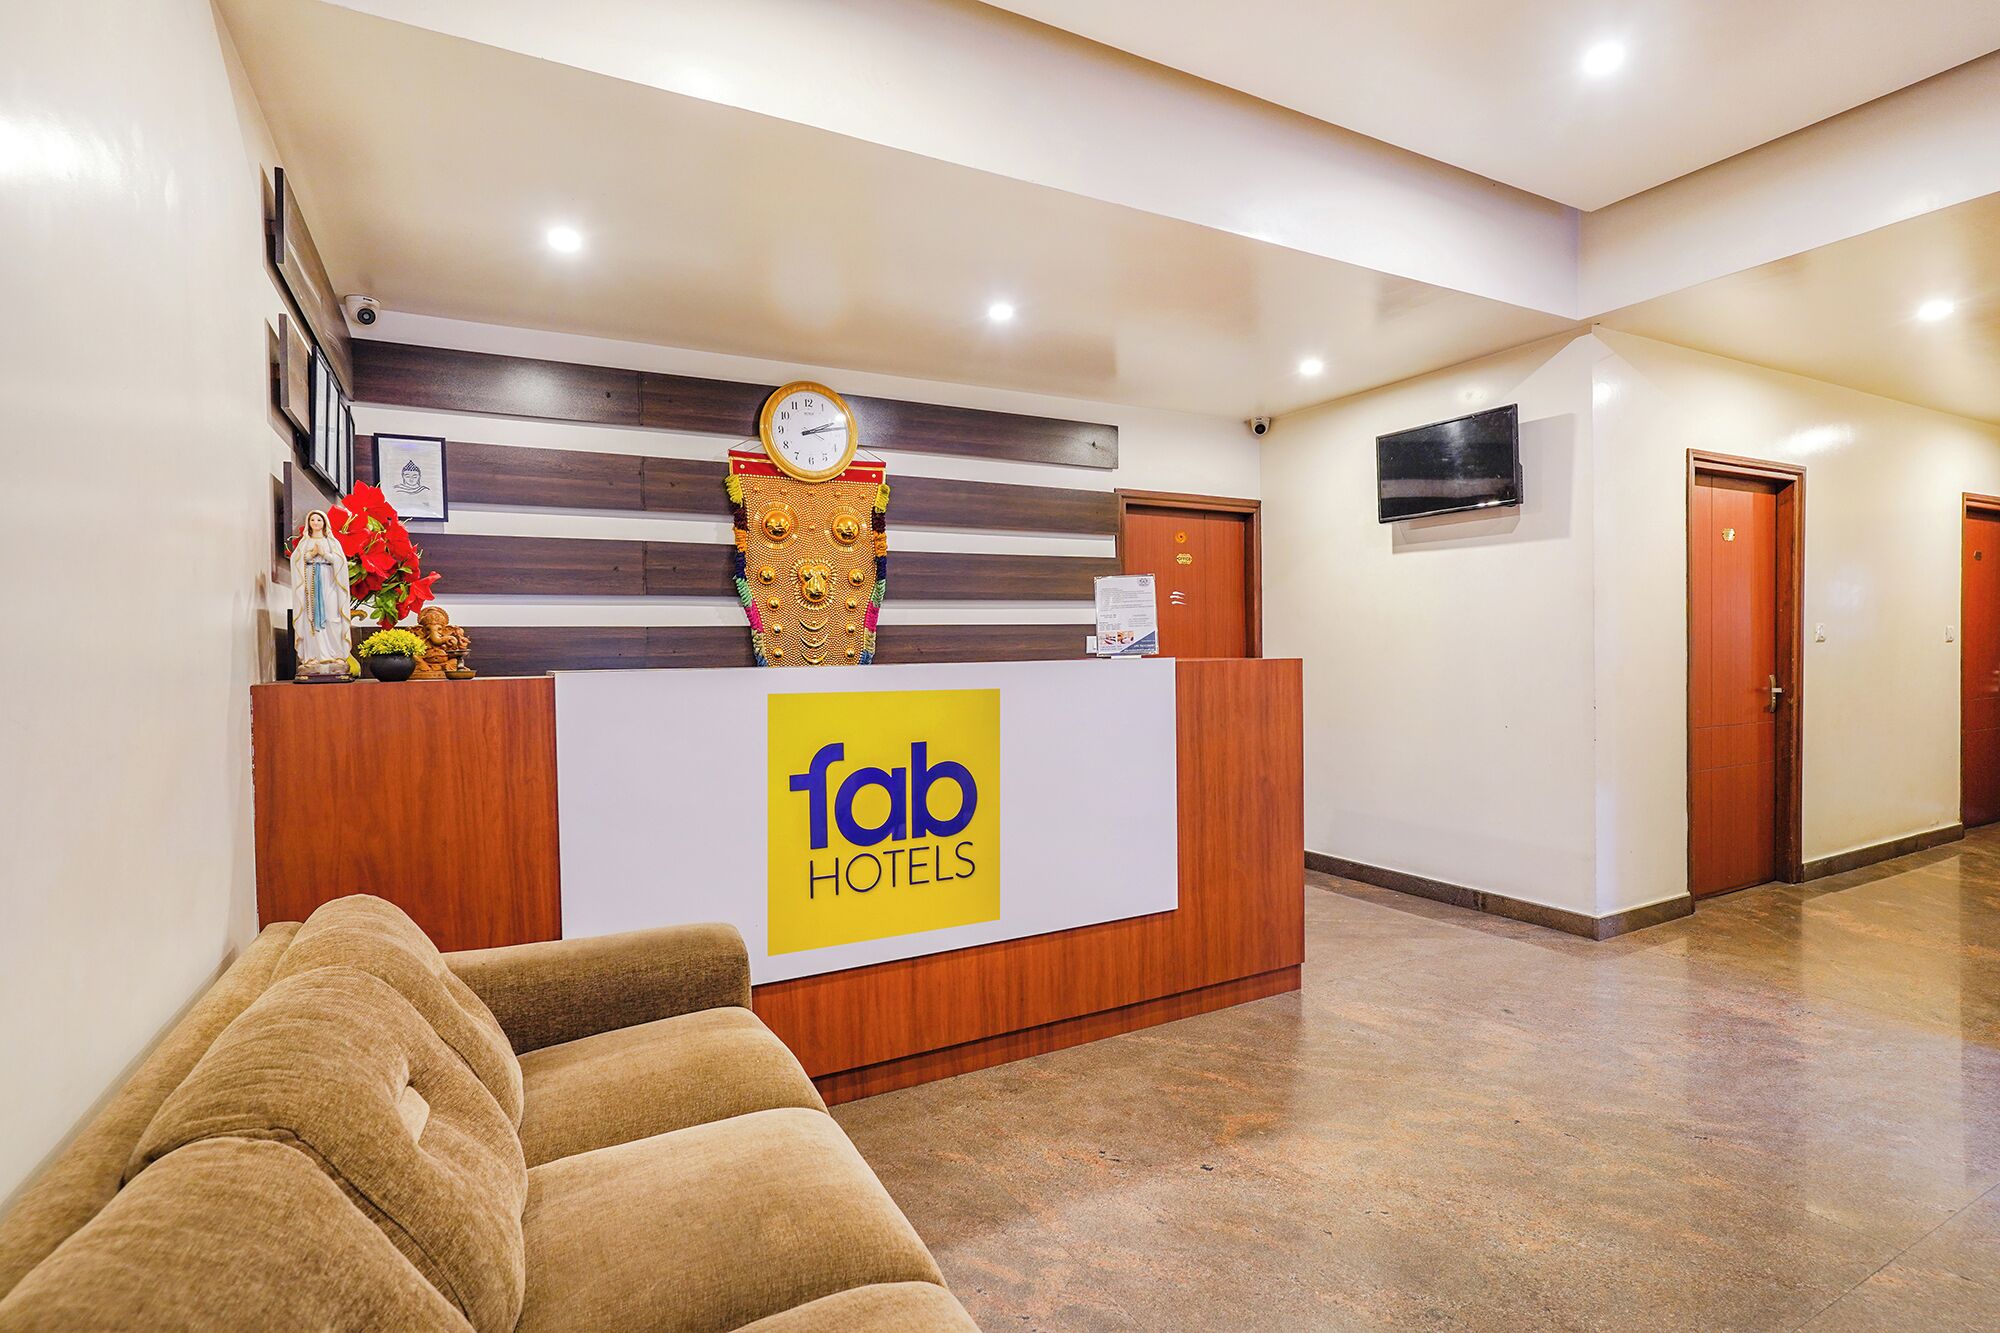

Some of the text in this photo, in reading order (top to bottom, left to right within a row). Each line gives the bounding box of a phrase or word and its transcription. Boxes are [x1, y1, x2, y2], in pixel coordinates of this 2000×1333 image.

[791, 401, 798, 410] 11
[804, 399, 813, 408] 12
[781, 411, 790, 420] 10
[777, 425, 785, 434] 9
[783, 440, 789, 449] 8
[794, 451, 800, 461] 7
[822, 453, 828, 462] 5
[808, 457, 815, 465] 6
[789, 741, 978, 850] fab
[810, 841, 975, 899] HOTELS
